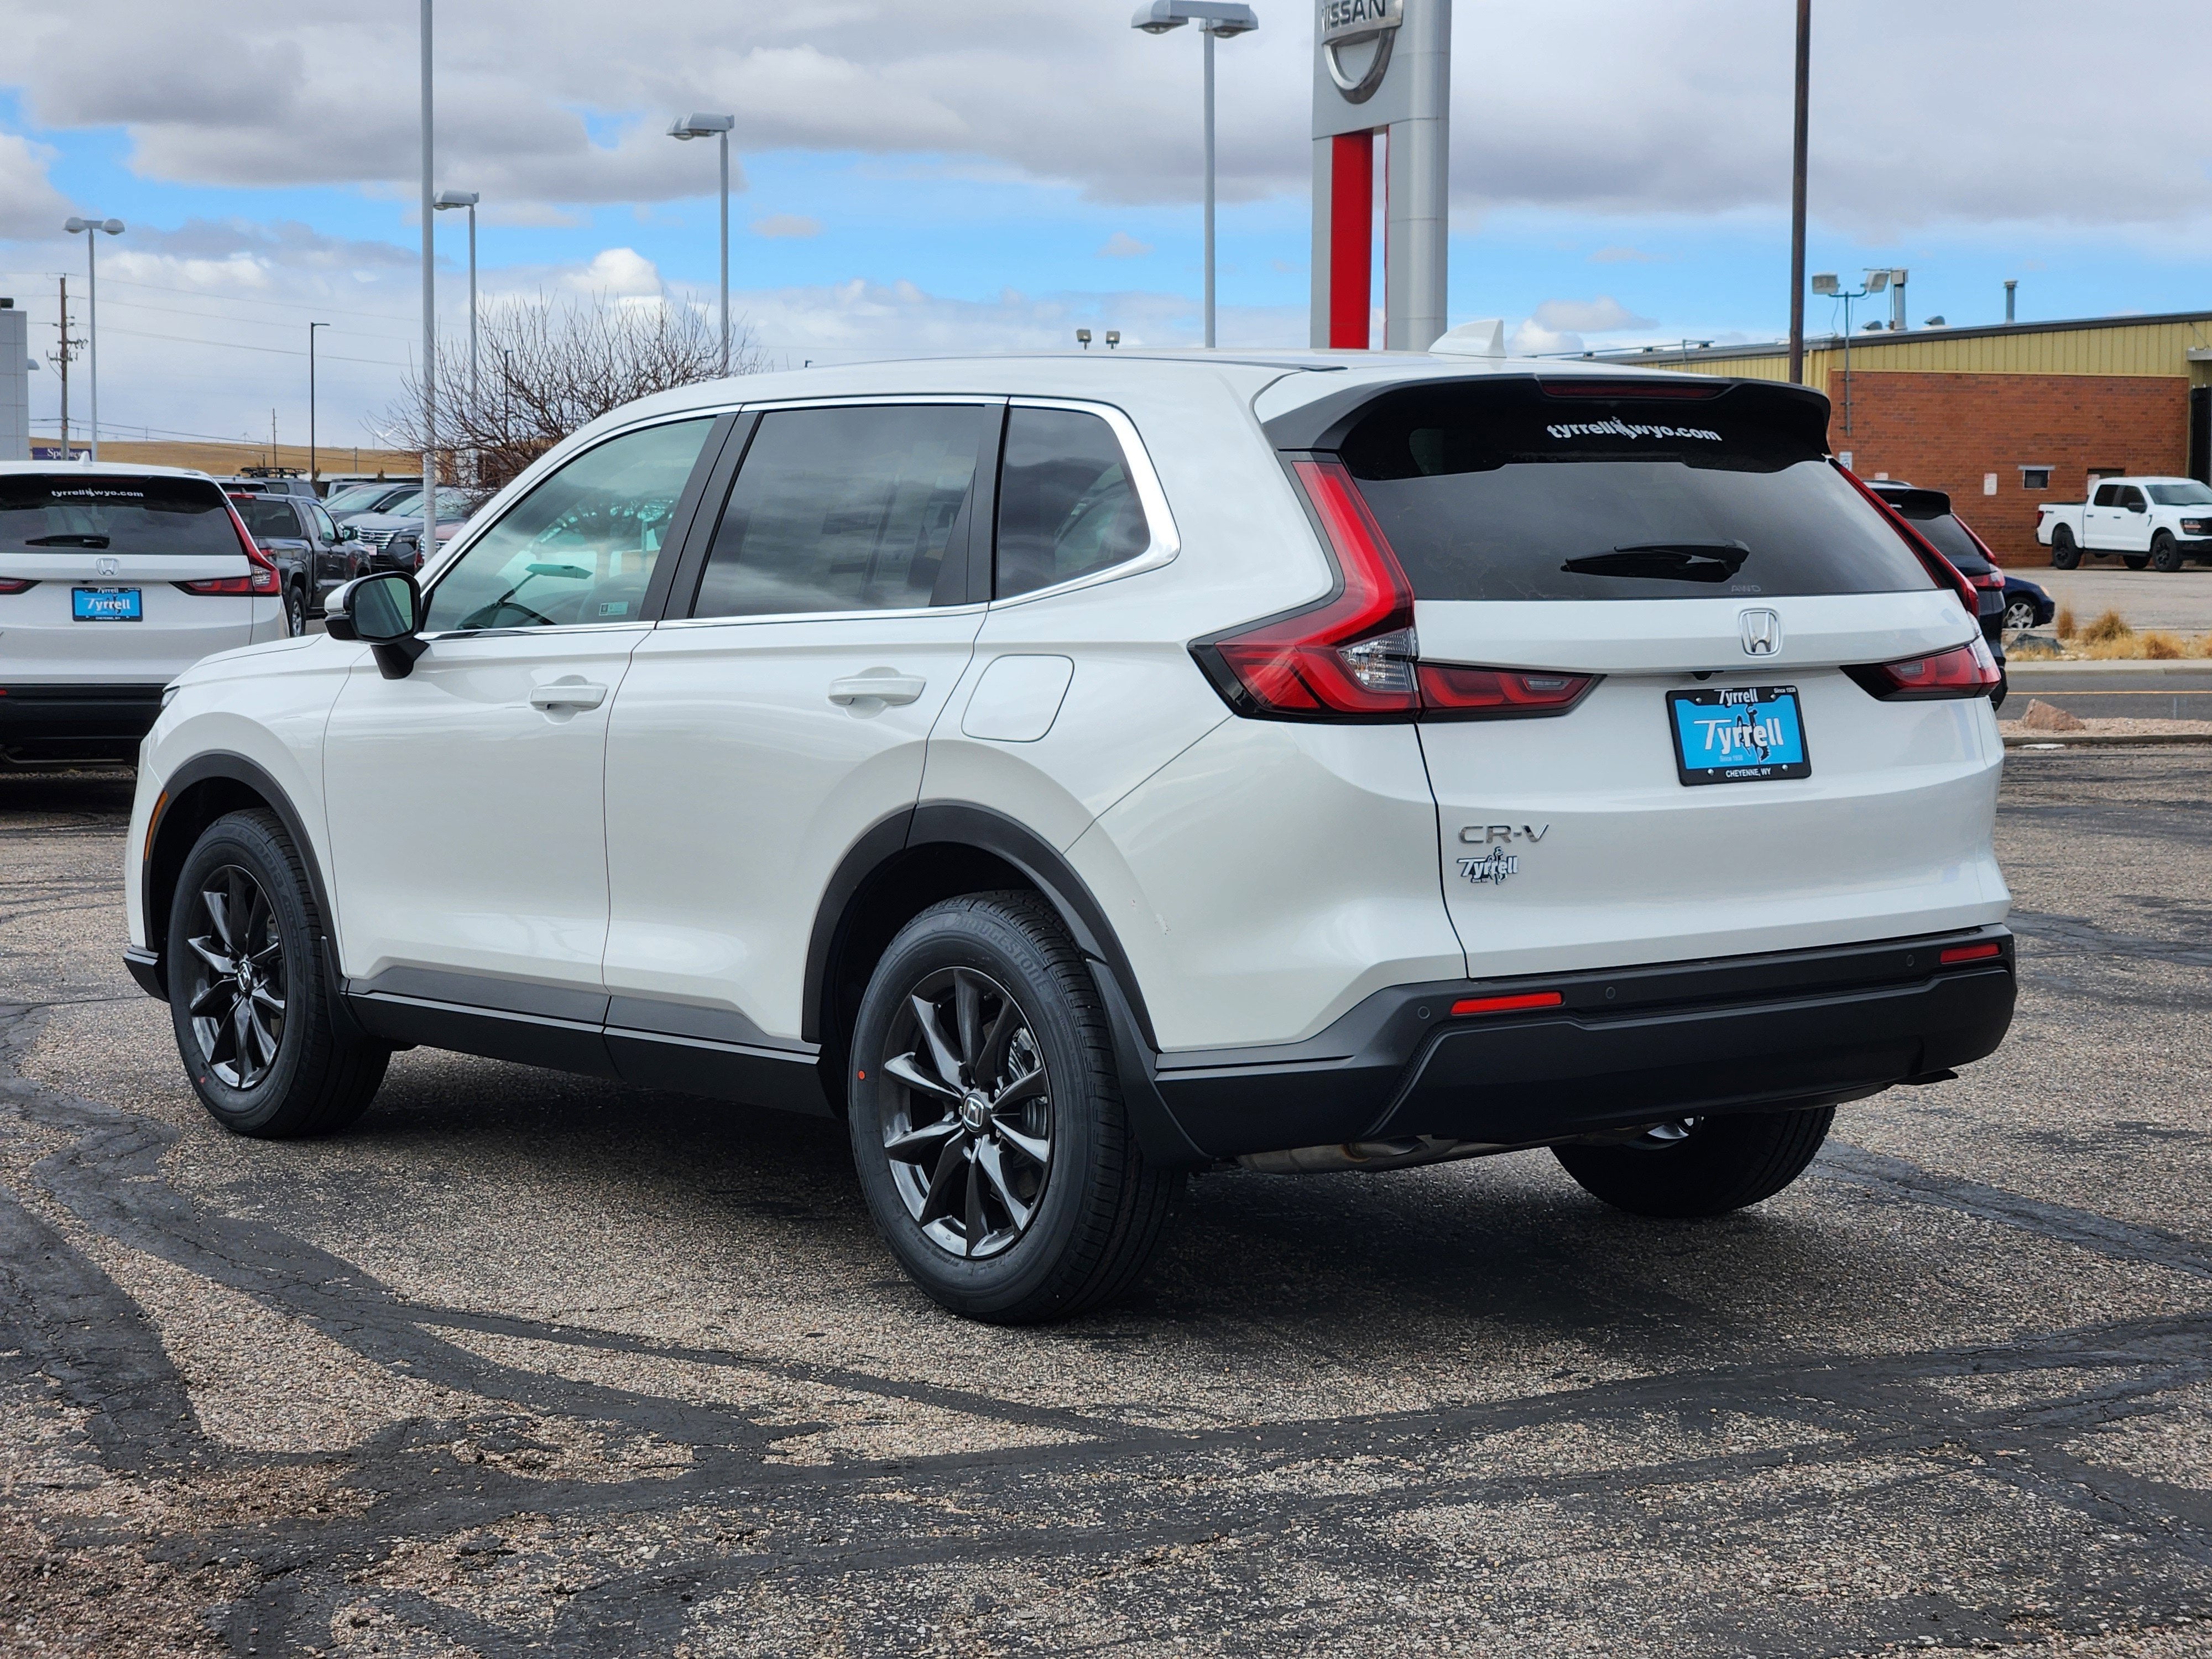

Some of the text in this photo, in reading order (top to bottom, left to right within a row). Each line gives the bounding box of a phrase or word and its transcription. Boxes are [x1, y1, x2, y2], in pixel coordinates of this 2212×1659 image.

[1322, 0, 1386, 32] NISSAN
[84, 598, 131, 612] Tyrrell
[1714, 688, 1759, 707] Tyrrell
[1693, 717, 1785, 755] Tyrrell
[1725, 767, 1771, 778] CHEYENNE, WY
[1458, 822, 1549, 844] CR-V
[1457, 855, 1519, 879] Tyrrell
